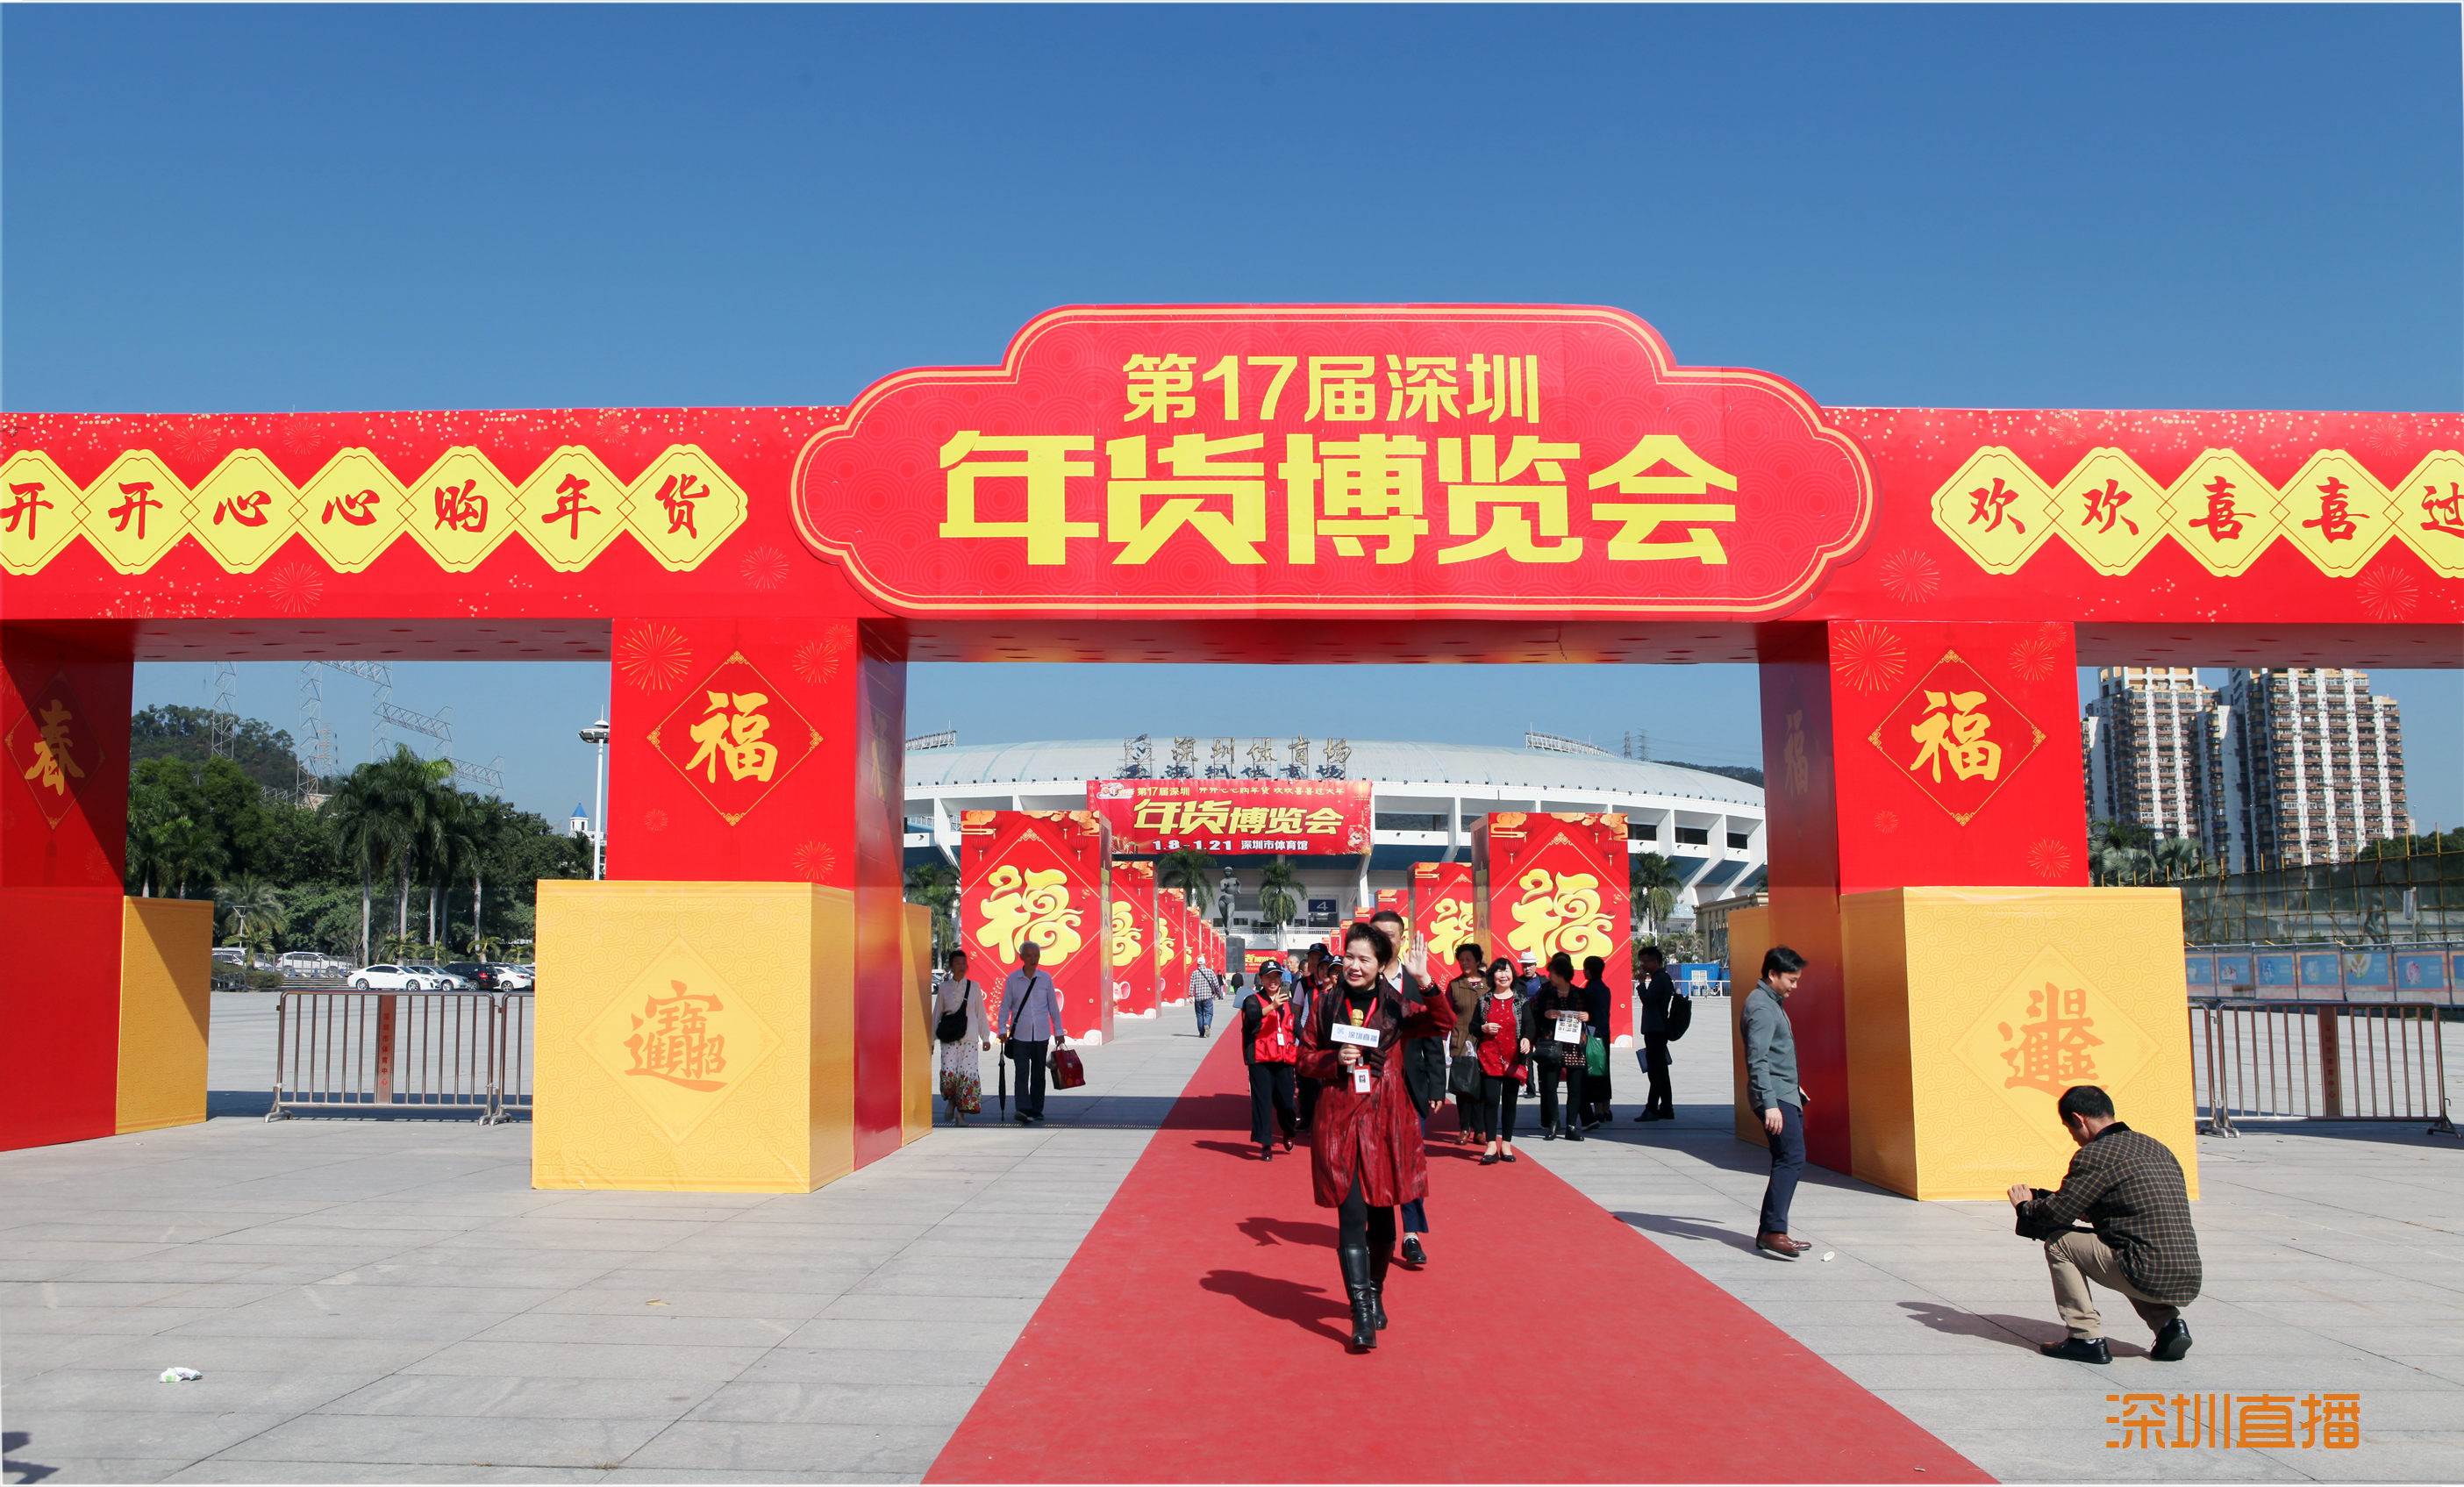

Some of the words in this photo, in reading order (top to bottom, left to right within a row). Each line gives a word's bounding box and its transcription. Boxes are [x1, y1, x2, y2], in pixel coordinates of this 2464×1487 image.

[1122, 354, 1539, 424] 第17届深圳
[0, 474, 710, 541] 开开心心购年货
[939, 430, 1738, 566] 年货博览会
[25, 699, 85, 796] 春
[685, 690, 778, 783] 福
[1171, 733, 1352, 765] 深圳体育场
[1910, 690, 2002, 783] 福
[1133, 798, 1344, 834] 年货博览会
[1137, 787, 1190, 796] 第17届深圳
[1241, 840, 1309, 850] 深圳市体育馆
[1317, 901, 1328, 911] 4
